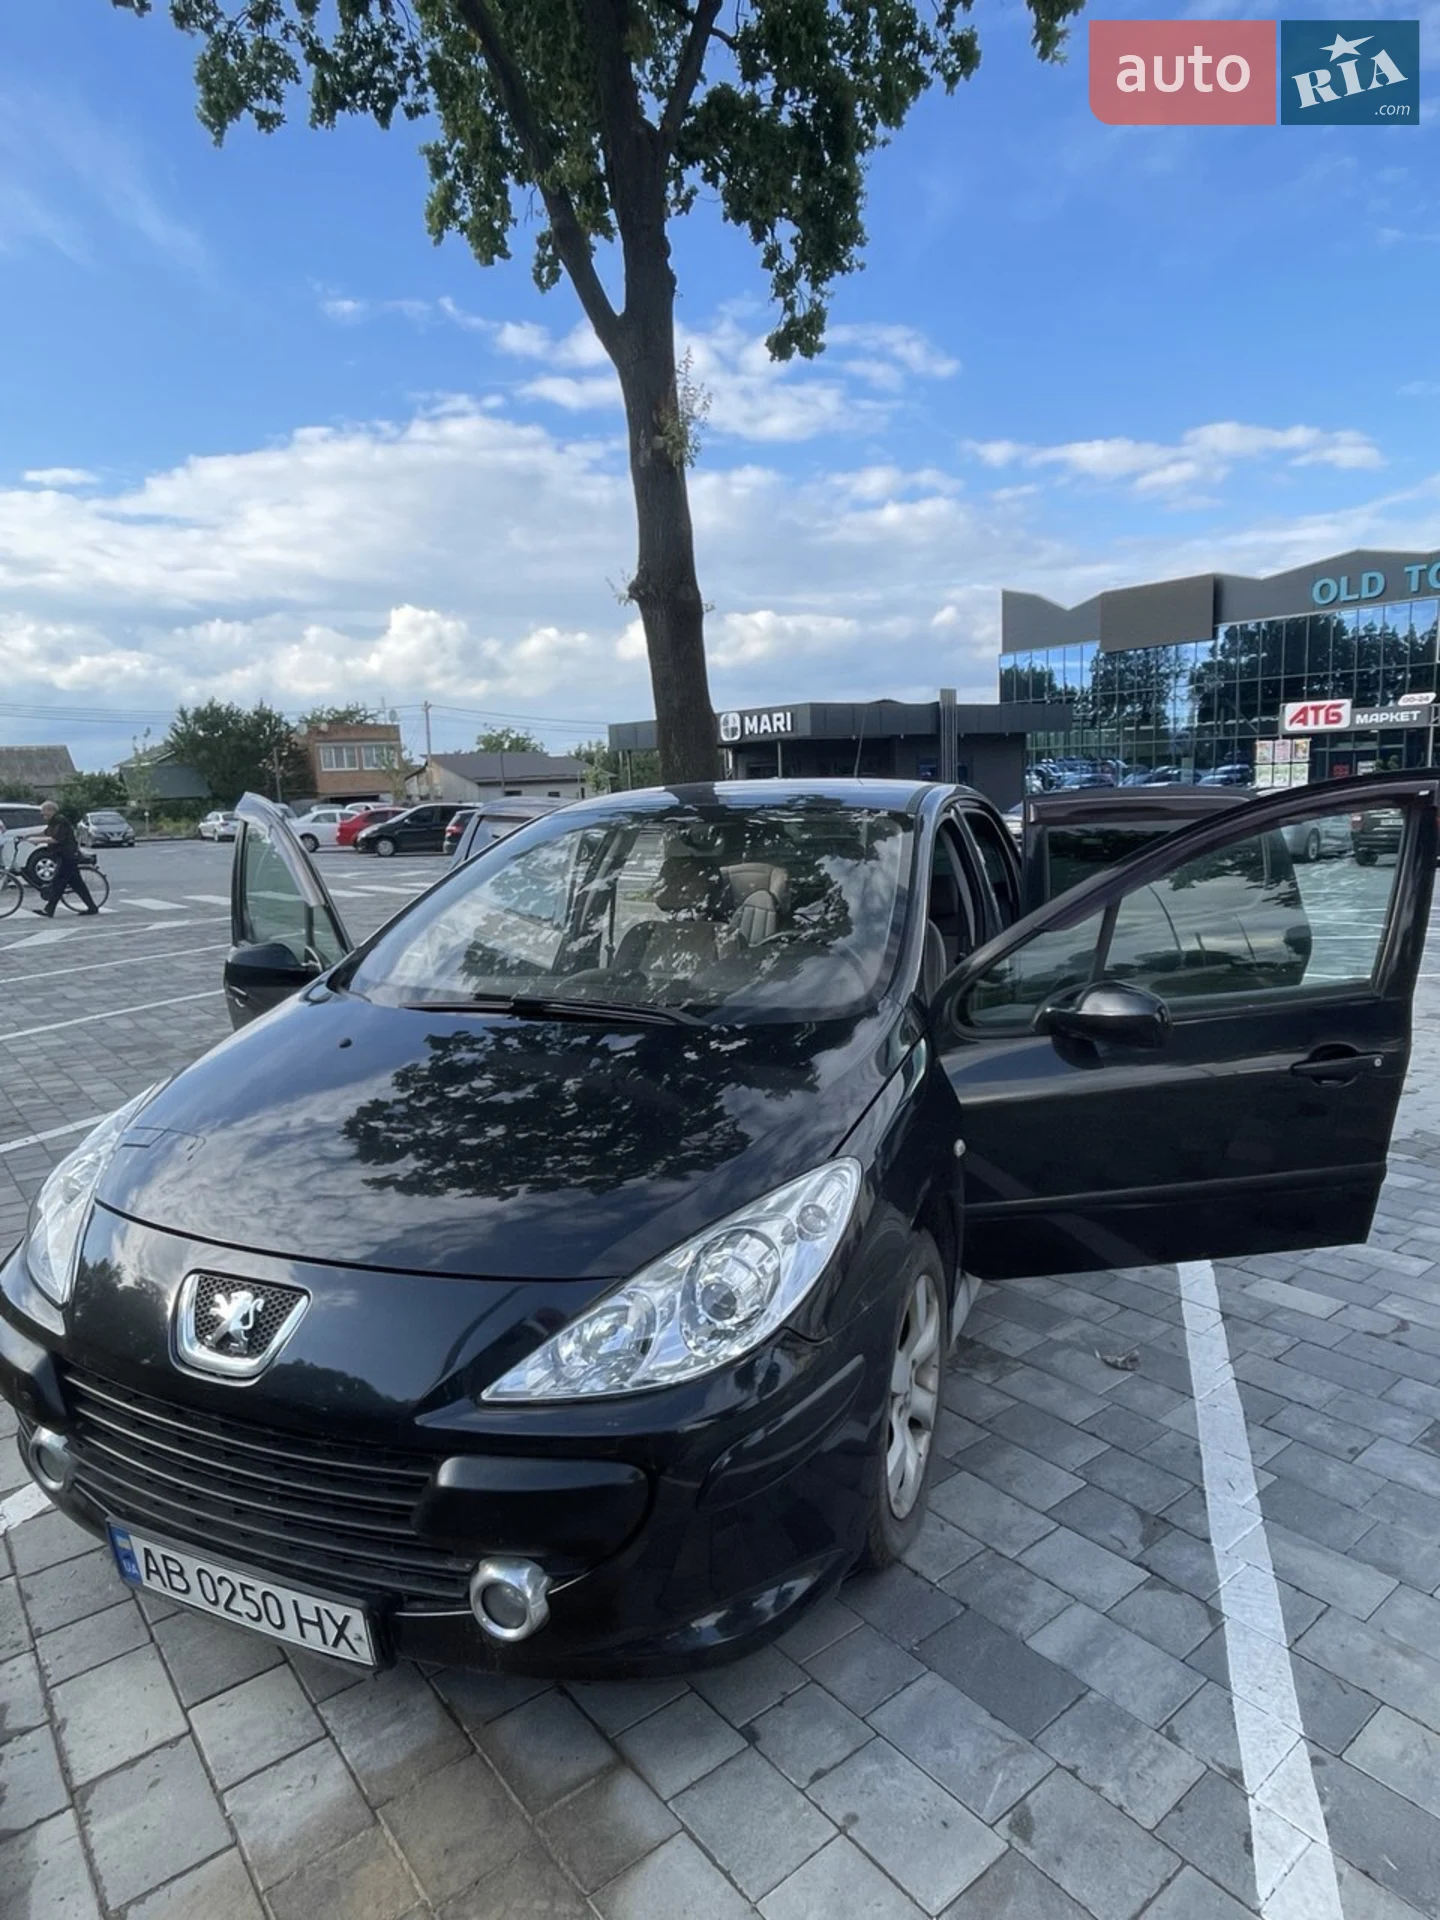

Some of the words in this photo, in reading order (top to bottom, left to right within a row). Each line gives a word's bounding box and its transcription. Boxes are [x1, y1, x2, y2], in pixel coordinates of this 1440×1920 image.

[1312, 571, 1385, 605] OLD
[744, 712, 792, 735] MARI
[1288, 703, 1346, 727] АТБ
[1355, 710, 1421, 725] МАРКЕТ
[143, 1547, 191, 1595] AB
[196, 1567, 286, 1630] 0250
[292, 1599, 359, 1655] HX
